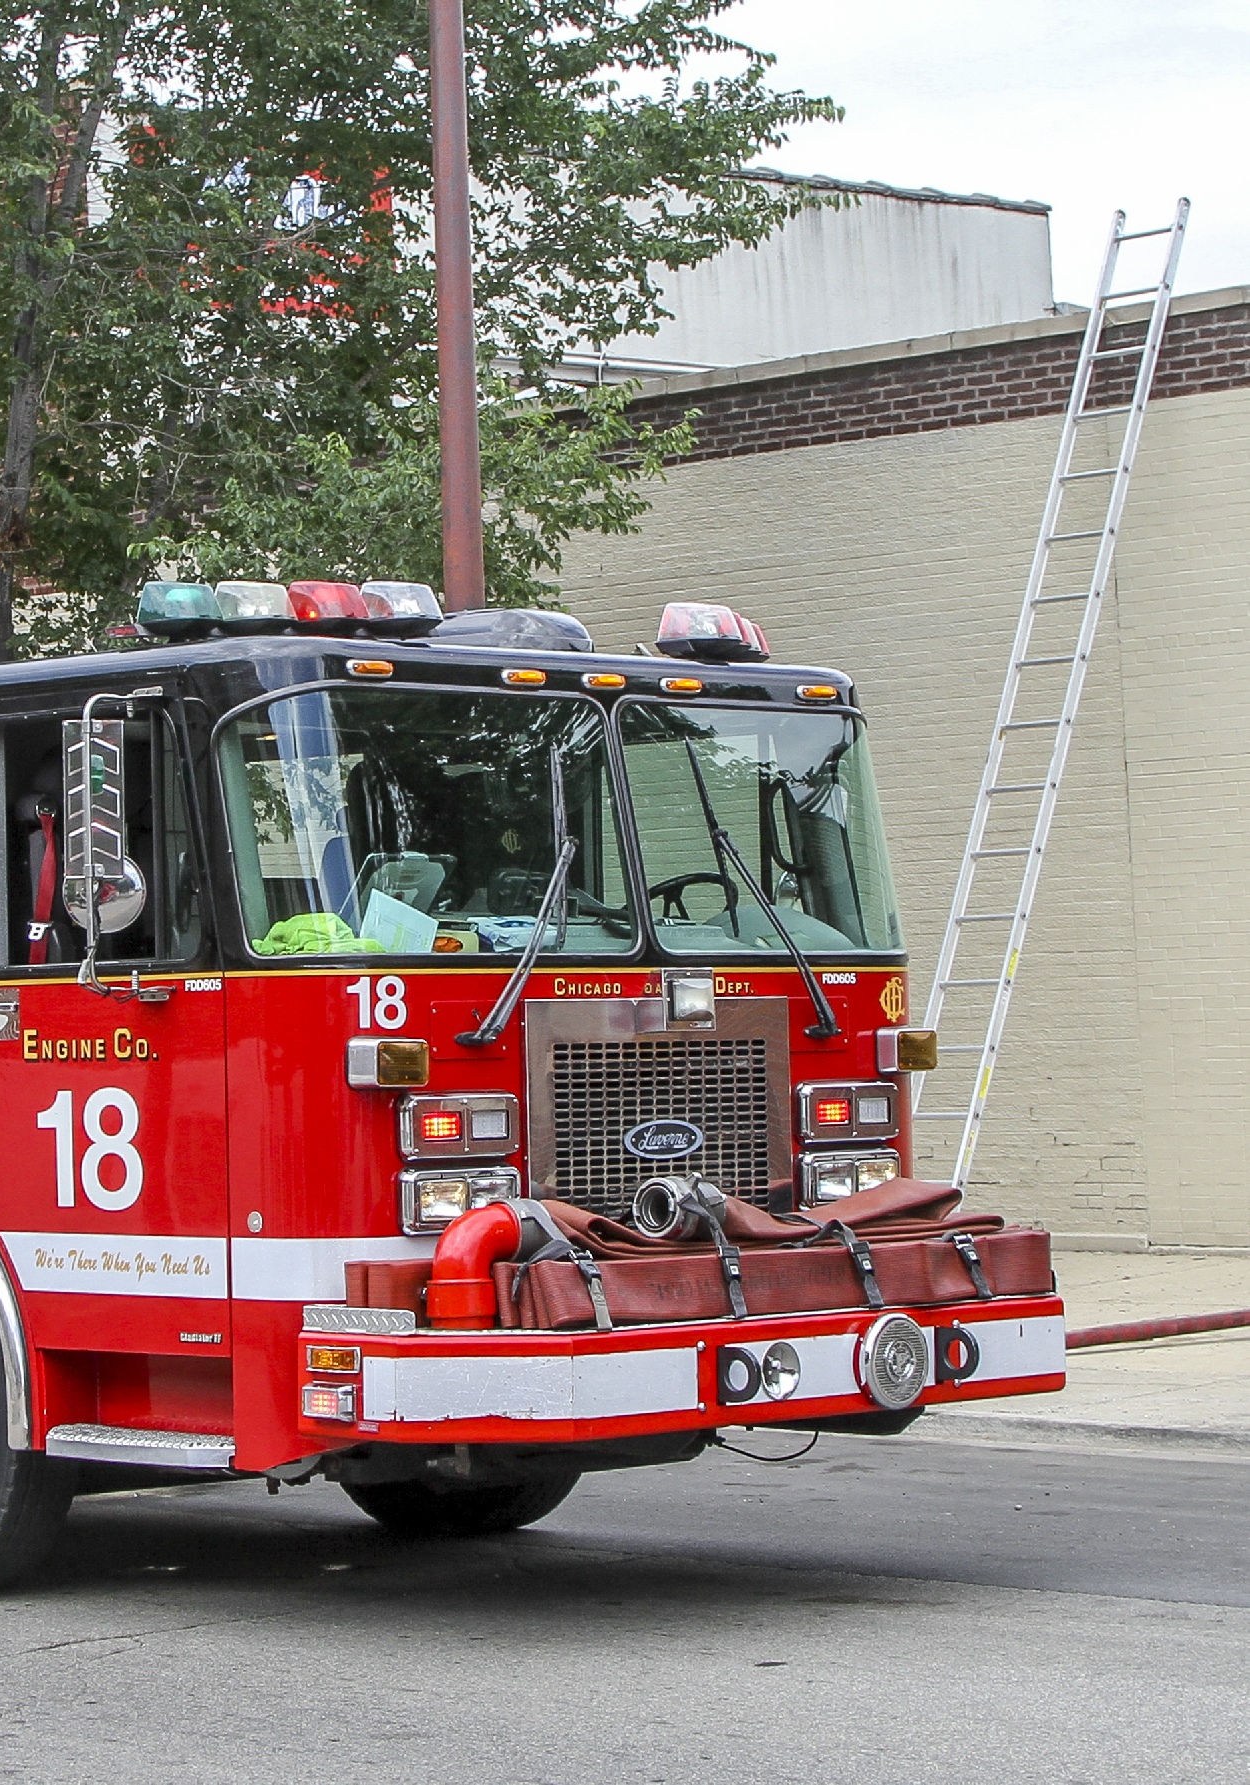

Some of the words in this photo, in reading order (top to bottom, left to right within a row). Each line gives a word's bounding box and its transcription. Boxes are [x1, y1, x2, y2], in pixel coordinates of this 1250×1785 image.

[184, 979, 222, 992] FDD605
[554, 977, 621, 995] CHICAGO
[822, 973, 856, 984] FDD605
[346, 975, 407, 1029] 18
[23, 1029, 106, 1061] ENGINE
[37, 1086, 144, 1211] 18
[34, 1247, 65, 1270] We're
[68, 1250, 97, 1271] There
[101, 1251, 130, 1272] When
[134, 1252, 156, 1281] You
[161, 1253, 189, 1275] Need
[193, 1255, 210, 1275] Us
